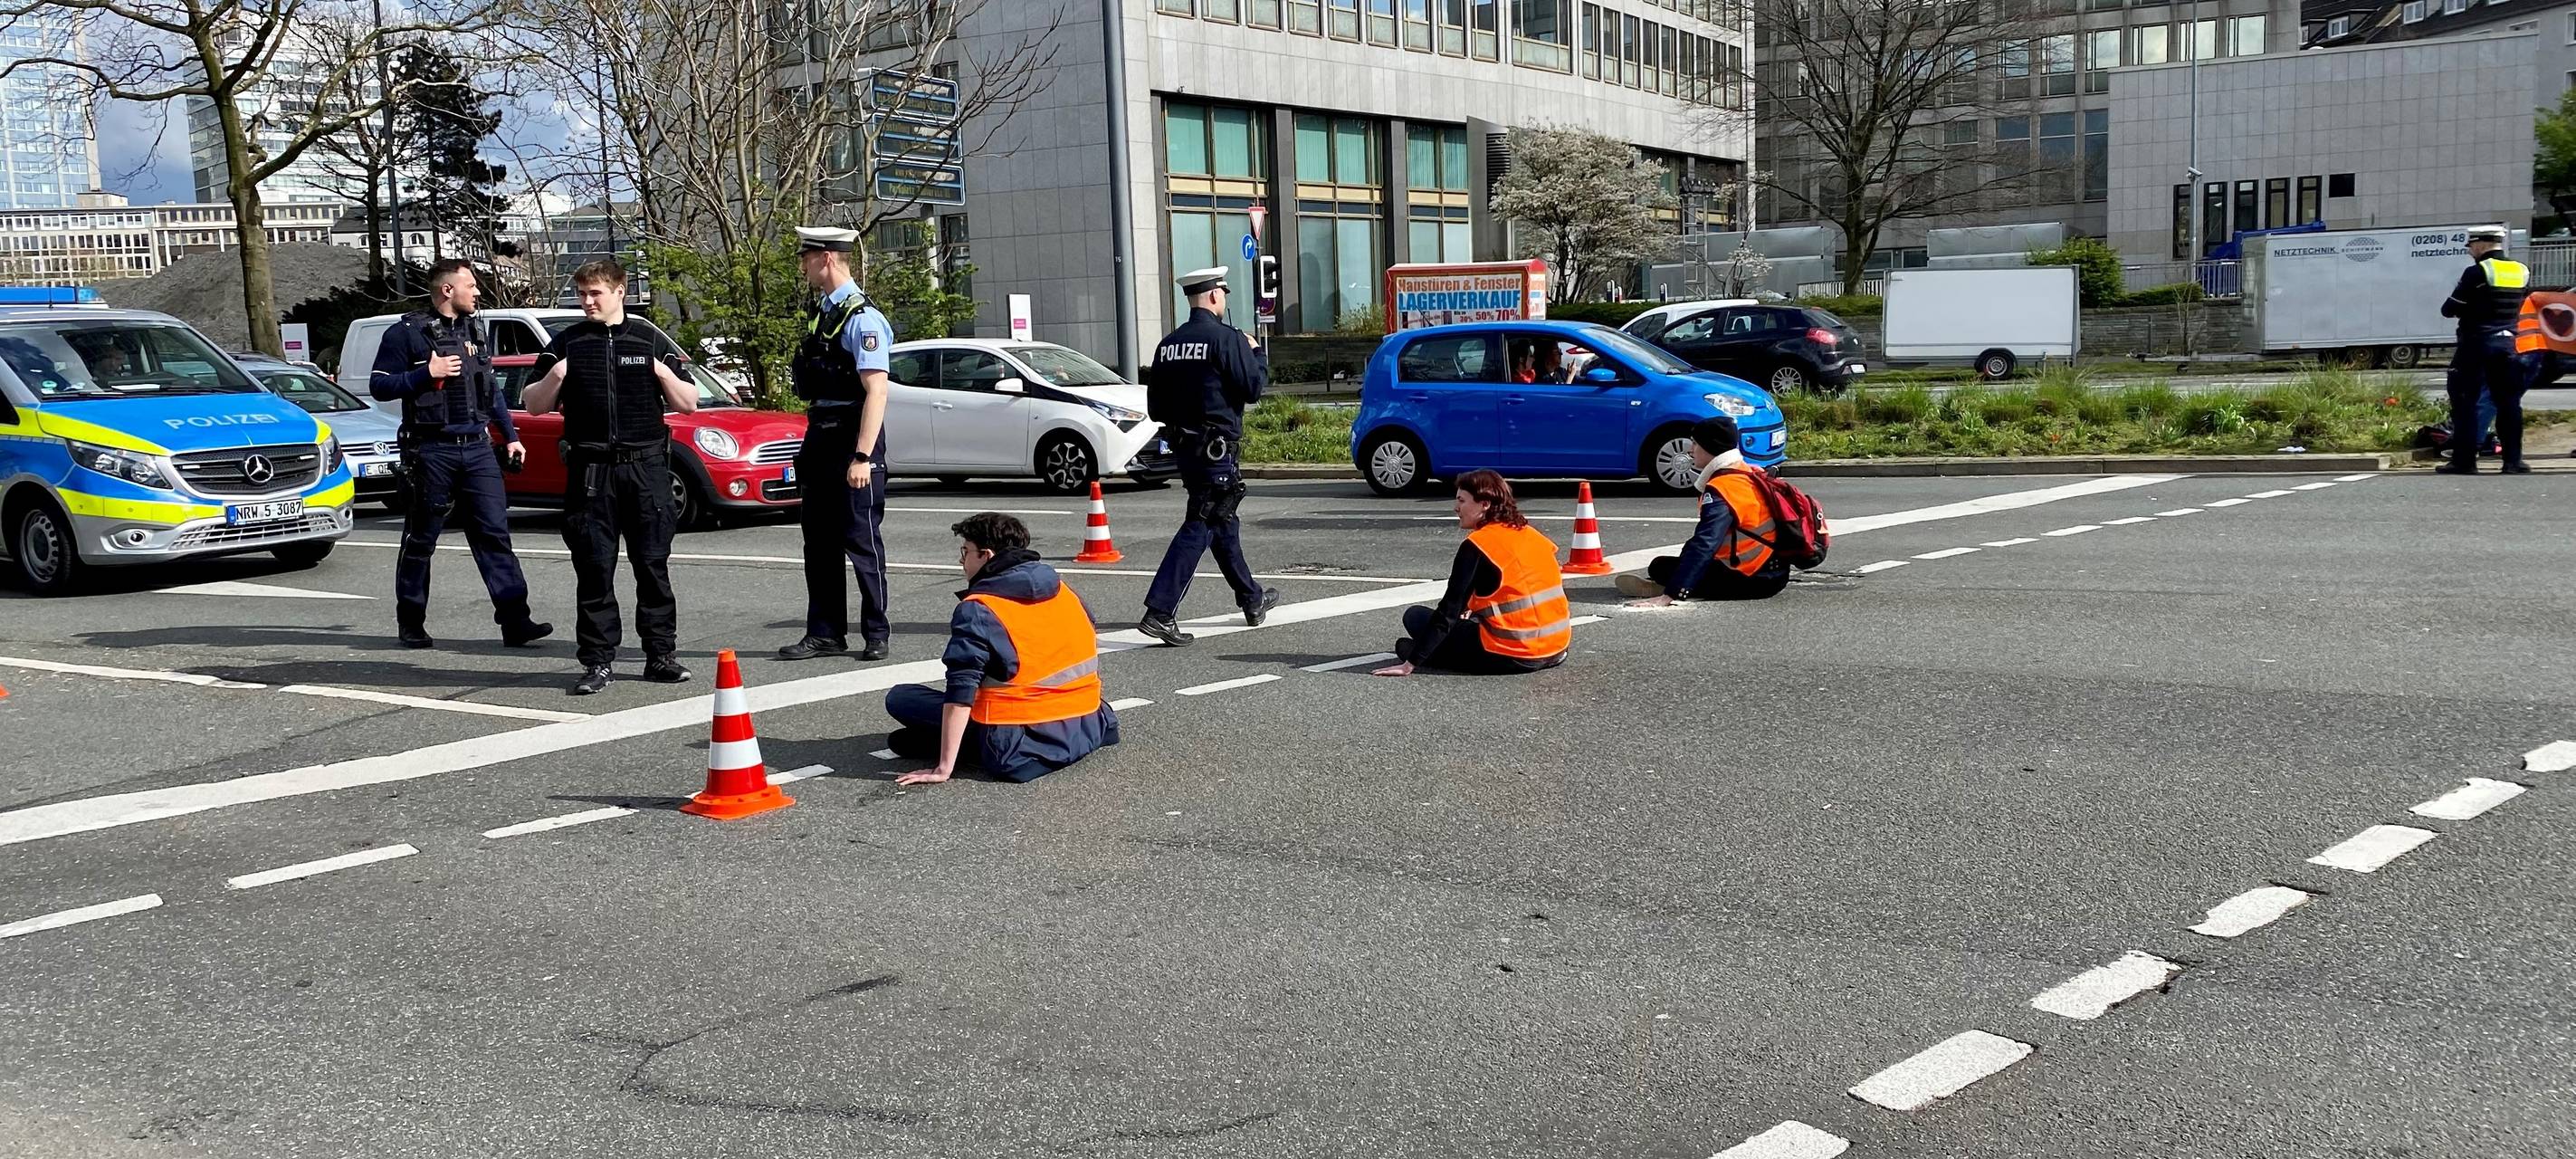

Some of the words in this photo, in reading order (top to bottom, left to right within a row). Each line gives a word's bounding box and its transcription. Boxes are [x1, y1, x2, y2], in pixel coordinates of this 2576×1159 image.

[2411, 235, 2447, 247] (0208)
[2451, 234, 2466, 243] 48
[2274, 246, 2336, 256] NETZTECHNIK
[2411, 246, 2468, 257] netztechn
[1398, 278, 1460, 292] Haustüren
[1463, 279, 1472, 291] &
[1474, 277, 1521, 290] Fenster
[1398, 291, 1521, 311] LAGERVERKAUF
[1475, 311, 1494, 321] 50%
[1495, 309, 1521, 321] 70%
[1160, 343, 1208, 362] POLIZEI
[621, 356, 645, 365] POLIZEI
[163, 414, 281, 429] POLIZEI
[236, 505, 259, 521] NRW
[276, 501, 301, 515] 3087
